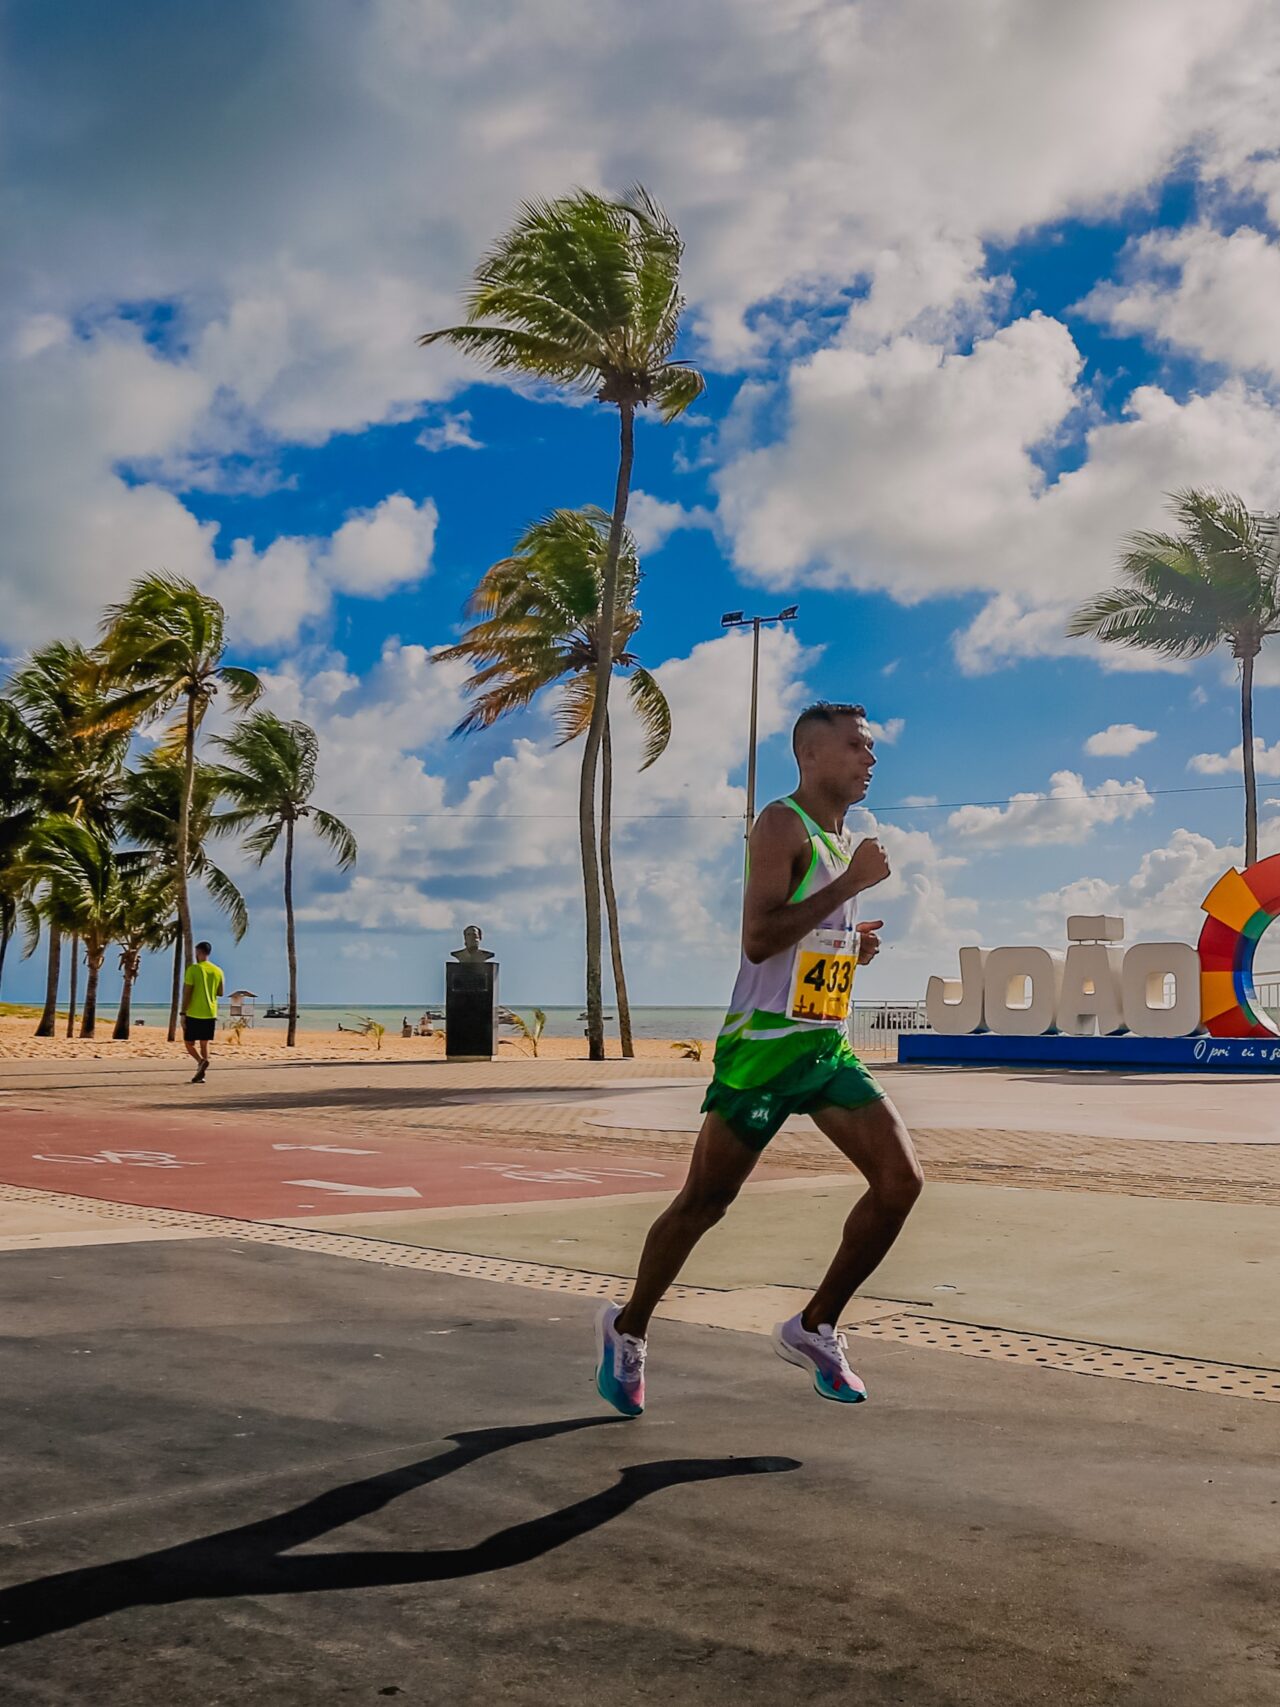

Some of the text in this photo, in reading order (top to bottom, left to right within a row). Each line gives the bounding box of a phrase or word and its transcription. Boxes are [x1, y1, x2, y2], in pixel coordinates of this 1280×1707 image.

[803, 958, 856, 994] 433
[925, 914, 1202, 1037] JOÃO
[1193, 1039, 1207, 1060] O
